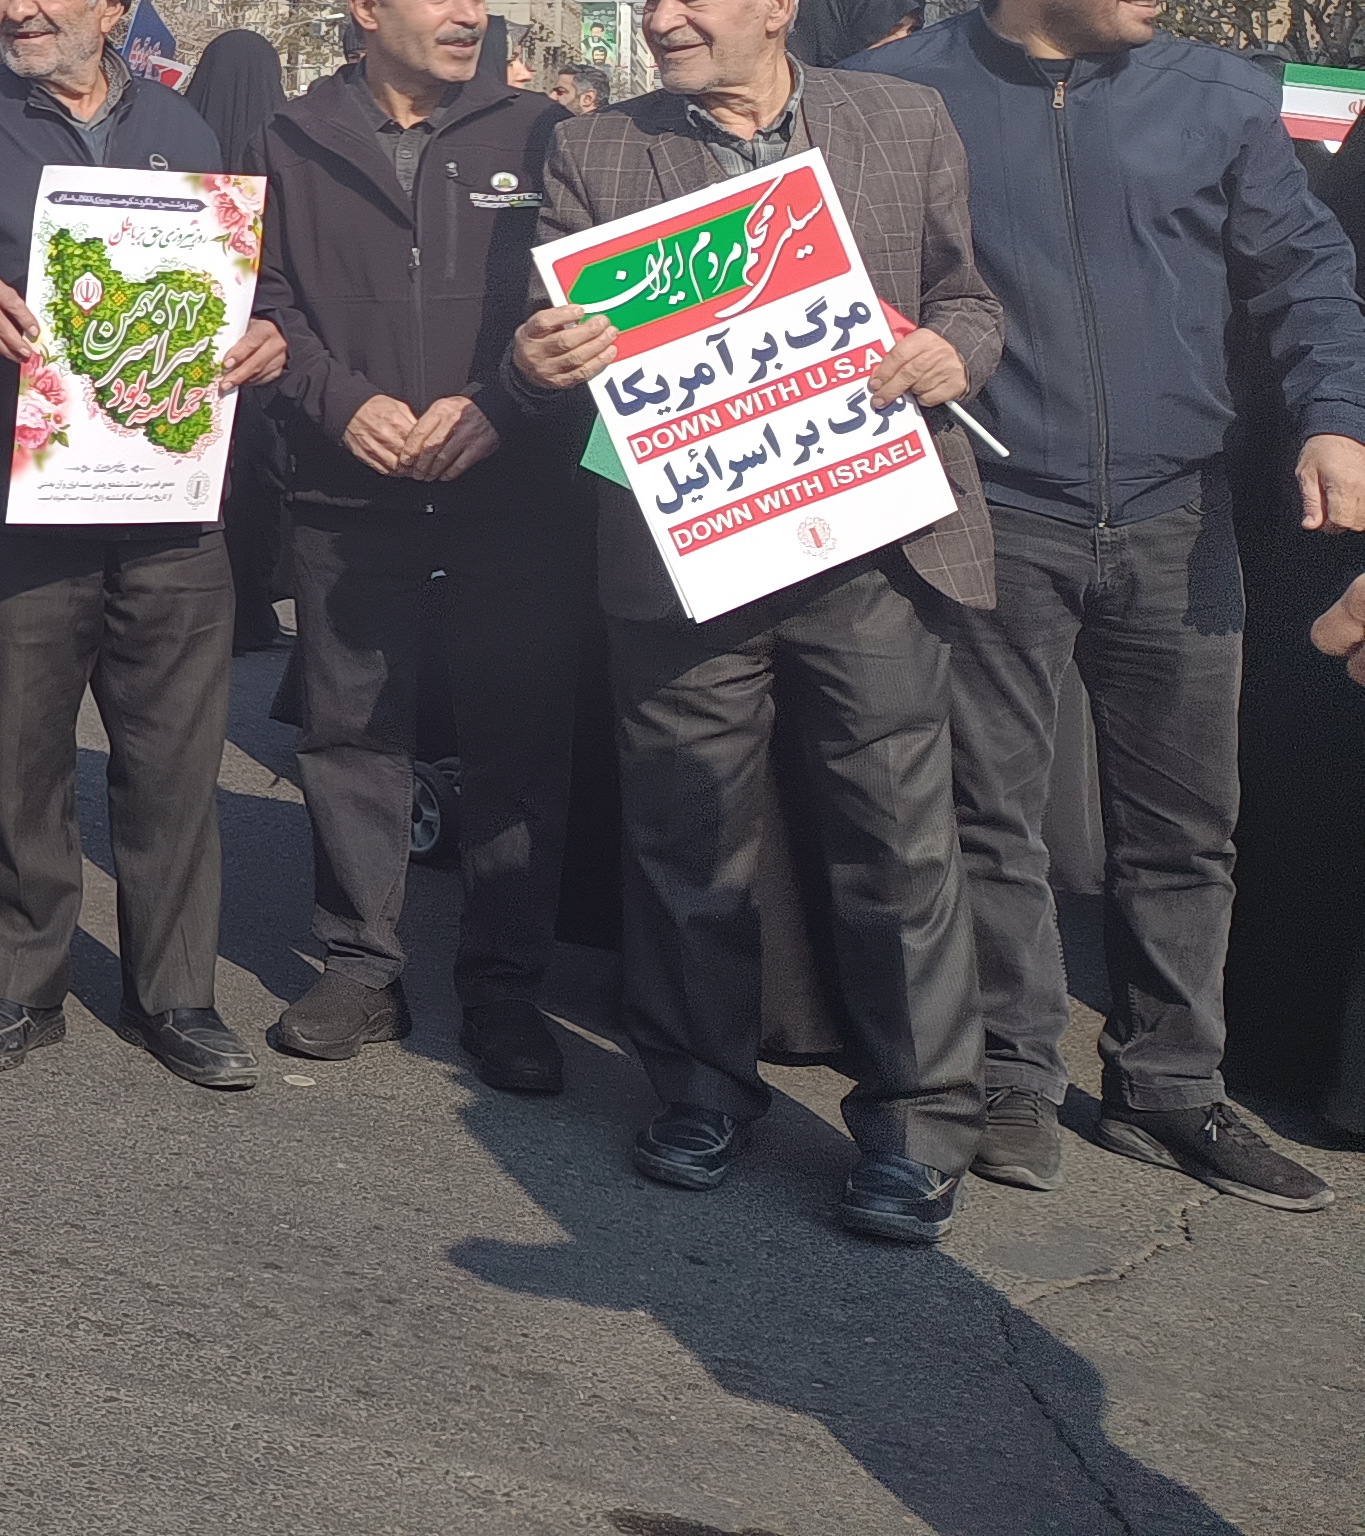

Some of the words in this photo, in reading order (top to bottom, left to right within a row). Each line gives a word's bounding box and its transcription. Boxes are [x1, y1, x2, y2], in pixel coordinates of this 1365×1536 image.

[82, 282, 167, 361] بهمن
[748, 331, 780, 384] بر
[784, 296, 872, 352] مرگ
[603, 327, 732, 418] آمریکا
[827, 387, 907, 437] مرگ
[631, 408, 723, 460] DOWN
[729, 378, 802, 424] WITH
[792, 420, 822, 465] بر
[654, 423, 783, 516] اسرائیل
[674, 505, 753, 551] DOWN
[757, 476, 825, 517] WITH
[830, 439, 922, 489] ISRAEL
